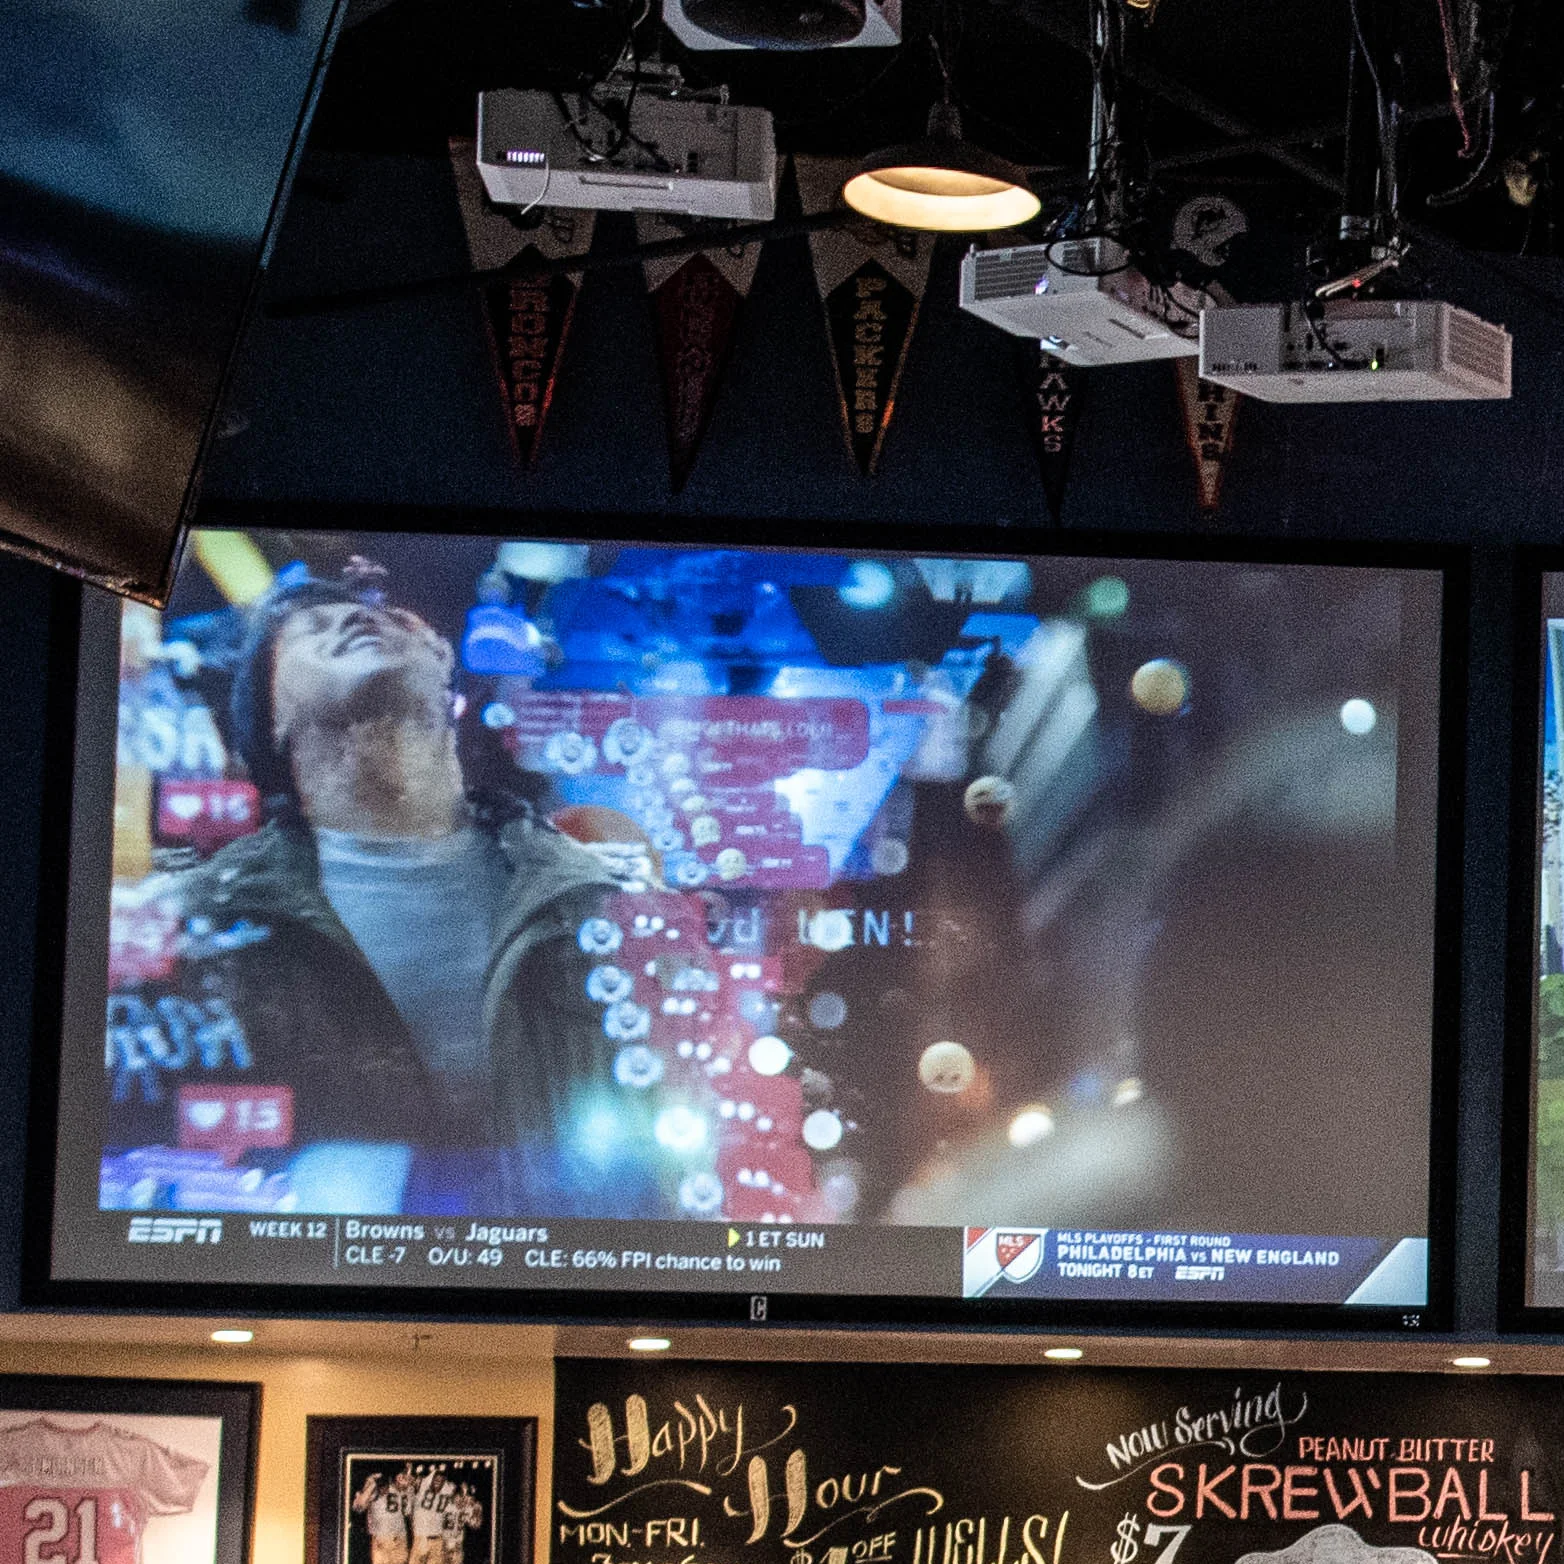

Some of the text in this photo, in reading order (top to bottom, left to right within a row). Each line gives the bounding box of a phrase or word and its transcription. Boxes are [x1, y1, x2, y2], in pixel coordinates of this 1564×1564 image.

[127, 1217, 223, 1243] ESPN
[249, 1221, 304, 1238] WEEK
[307, 1222, 327, 1238] 12
[346, 1221, 424, 1241] Browns
[465, 1223, 548, 1246] Jaguars
[756, 1231, 782, 1247] ET
[786, 1231, 825, 1248] SUN
[1085, 1233, 1143, 1245] PLAYOFFS
[1154, 1235, 1184, 1246] FIRST
[1188, 1236, 1231, 1247] ROUND
[345, 1246, 385, 1264] CLE
[428, 1246, 472, 1266] O/U:
[474, 1247, 502, 1266] 49
[524, 1248, 568, 1267] CLE:
[572, 1249, 617, 1269] 66%
[621, 1251, 651, 1269] FPI
[655, 1252, 721, 1270] chance
[725, 1253, 745, 1271] to
[749, 1255, 781, 1273] win
[1057, 1246, 1186, 1263] PHILADELPHIA
[1211, 1247, 1253, 1265] NEW
[1257, 1248, 1339, 1266] ENGLAND
[1057, 1262, 1224, 1281] TONIGHT ESPN
[1175, 1382, 1290, 1456] Serving
[579, 1393, 780, 1485] Happy
[1299, 1436, 1495, 1463] PEANUT BUTTER
[723, 1449, 902, 1546] Hour
[1146, 1463, 1555, 1522] SKREWBALL
[852, 1532, 896, 1560] OFF
